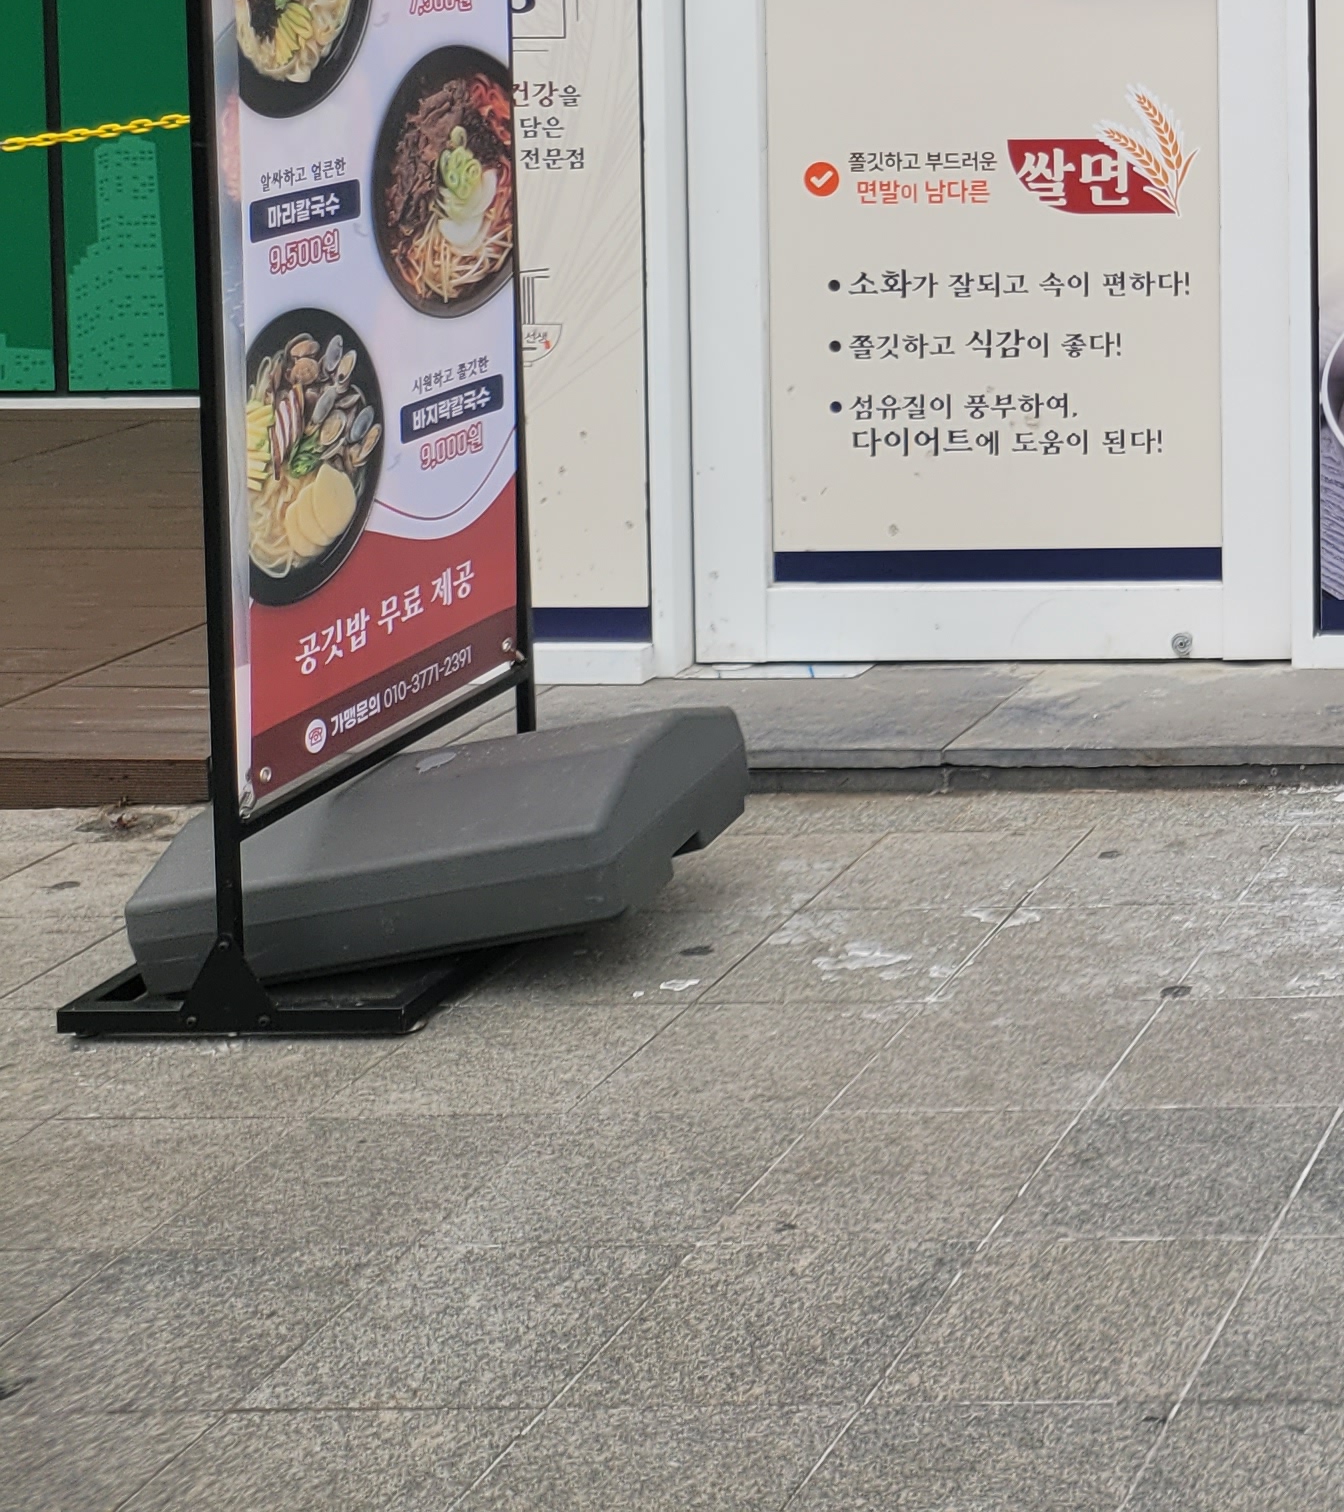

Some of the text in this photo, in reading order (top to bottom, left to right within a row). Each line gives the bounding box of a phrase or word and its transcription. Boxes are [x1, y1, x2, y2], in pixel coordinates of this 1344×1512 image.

[519, 116, 565, 139] 담은
[260, 157, 347, 193] 알싸하고 얼큰한
[520, 147, 585, 170] 전문점
[848, 150, 998, 172] 쫄깃하고 부드러운
[856, 179, 990, 205] 면발이 남다른
[1014, 147, 1133, 207] 쌀면
[267, 192, 341, 229] 마라칼국수
[269, 228, 341, 275] 9,500원
[847, 269, 1192, 299] 소화가 잘되고 속이 편하다!
[848, 328, 1123, 360] 쫄깃하고 식감이 좋다!
[412, 354, 490, 395] 시원하고 쫄깃한
[412, 386, 492, 431] 바지락칼국수
[849, 392, 1079, 420] 섬유질이 풍부하여,
[420, 421, 484, 471] 9,000원
[852, 428, 1165, 457] 다이어트에 도움이 된다!
[294, 558, 476, 676] 공깃밥 무료 제공
[330, 643, 472, 738] 가맹문의 010-3771-2391
